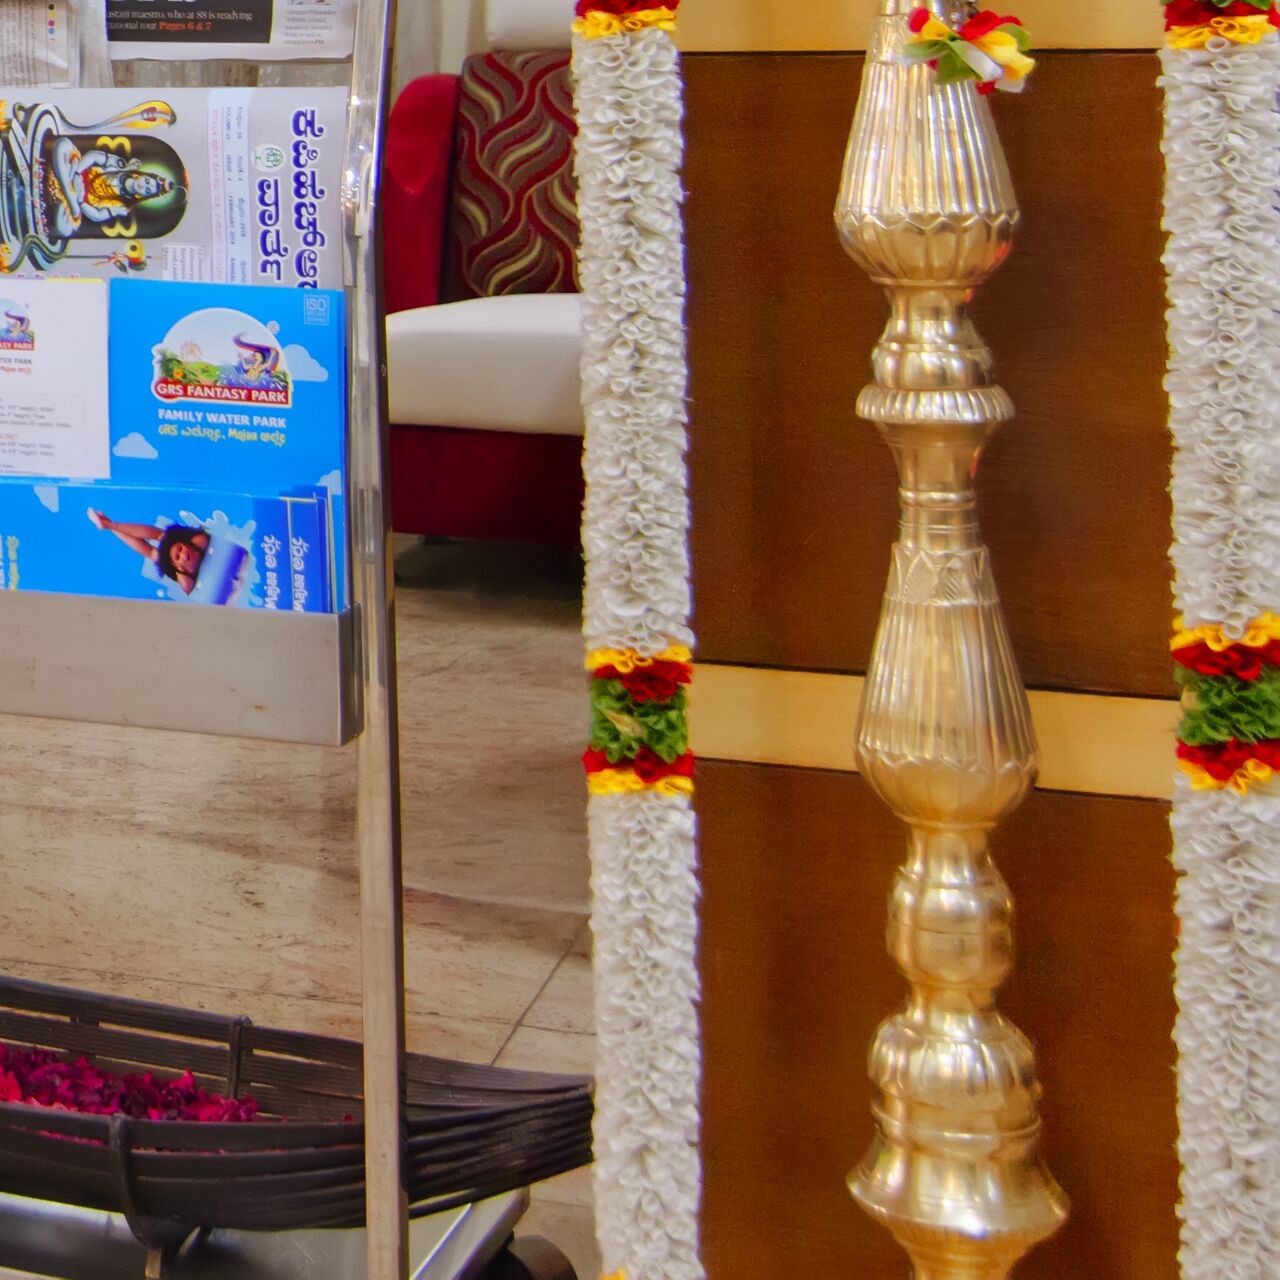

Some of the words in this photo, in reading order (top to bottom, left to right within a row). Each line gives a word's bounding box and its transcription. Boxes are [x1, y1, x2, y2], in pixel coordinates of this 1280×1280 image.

[307, 298, 326, 311] ISO
[157, 383, 184, 396] GRS
[187, 385, 248, 401] FANTASY
[252, 390, 286, 403] PARK
[158, 408, 203, 423] FAMILY
[206, 411, 250, 426] WATER
[253, 416, 286, 429] PARK
[264, 571, 280, 609] Majaa
[293, 574, 308, 611] Majaa
